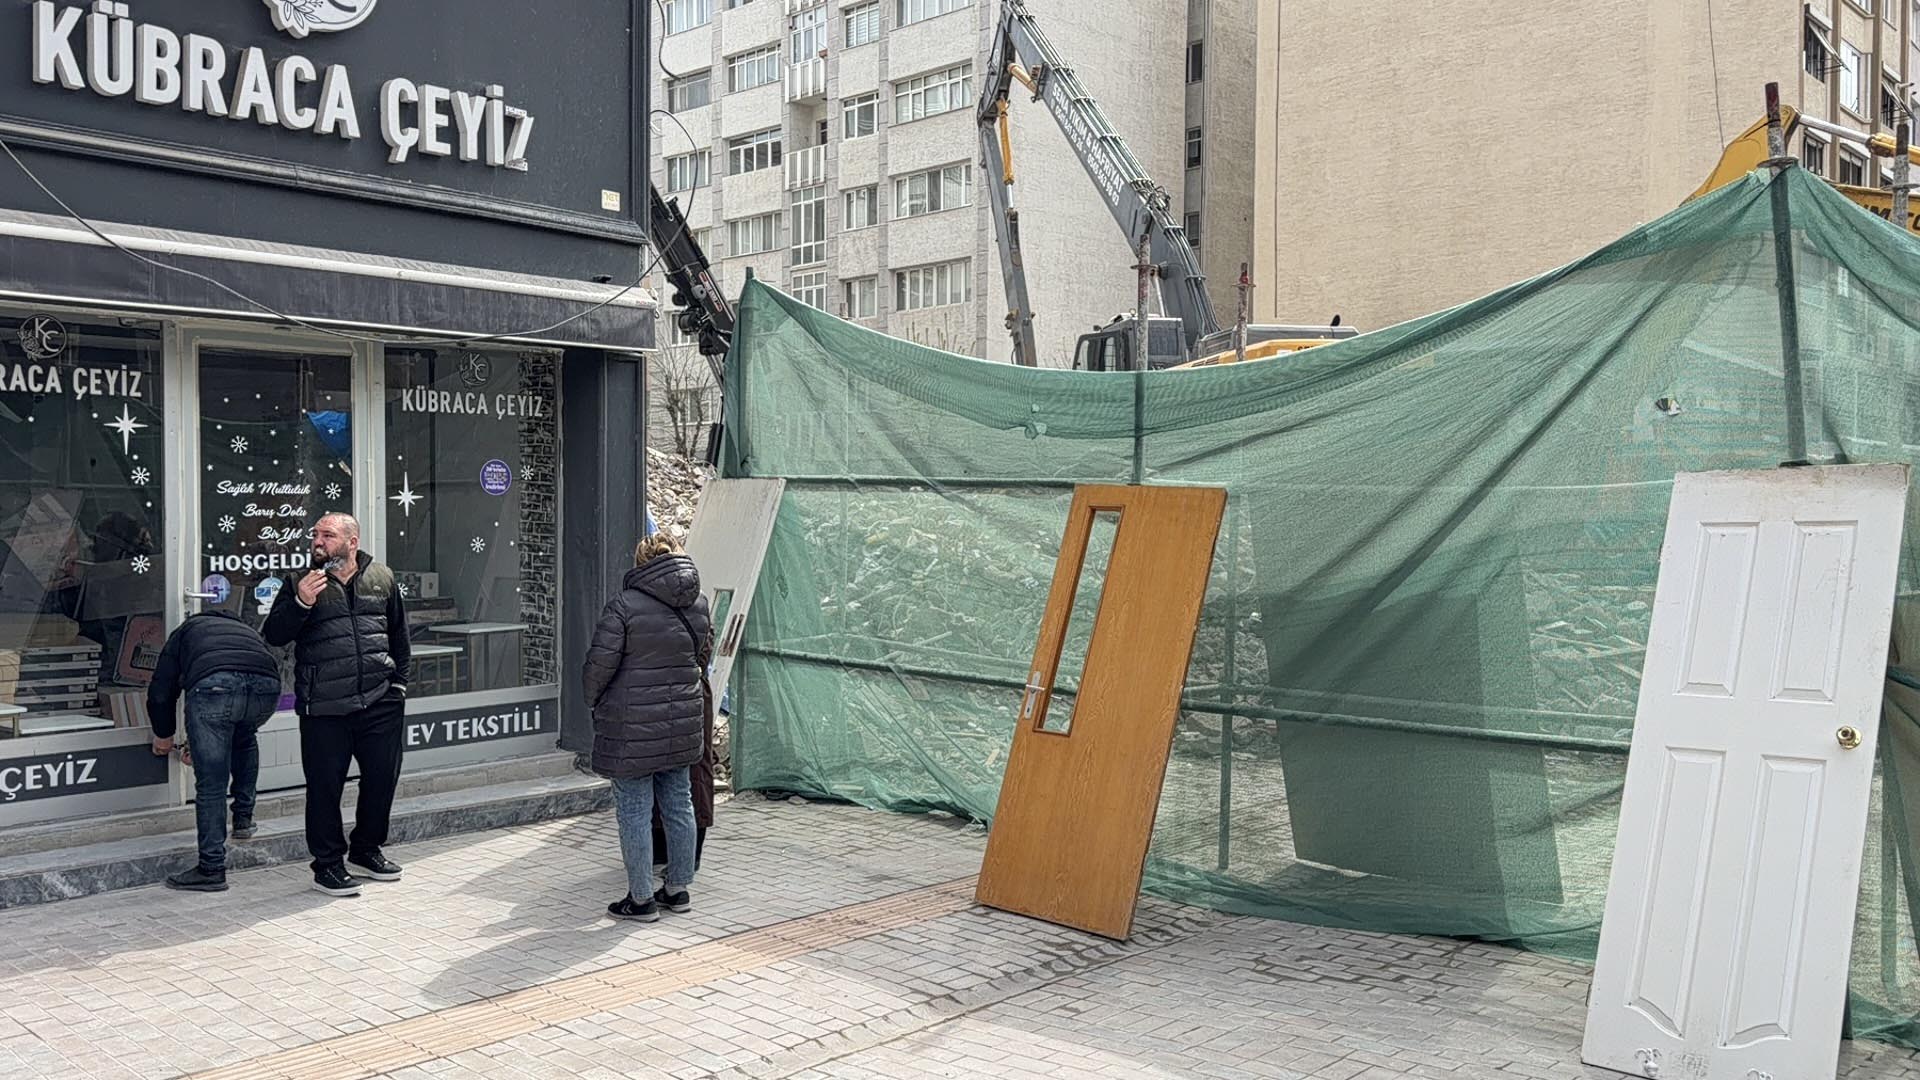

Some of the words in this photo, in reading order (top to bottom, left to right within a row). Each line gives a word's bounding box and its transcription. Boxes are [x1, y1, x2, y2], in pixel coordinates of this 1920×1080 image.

[32, 0, 361, 139] KÜBRACA
[380, 77, 534, 172] ÇEYİZ
[1068, 105, 1089, 141] YIKIM
[1090, 138, 1125, 193] HAFRİYAT
[72, 364, 142, 400] ÇEYİZ
[402, 385, 489, 415] KÜBRACA
[496, 391, 543, 420] ÇEYİZ
[216, 480, 255, 496] Sağlık
[258, 482, 311, 496] Mutluluk
[242, 503, 275, 519] Barış
[276, 504, 307, 517] Dolu
[257, 526, 281, 540] Bir
[209, 548, 312, 575] HOŞGELDİ
[407, 722, 436, 746] EV
[442, 705, 541, 741] TEKSTİLİ
[0, 754, 98, 801] ÇEYİZ
